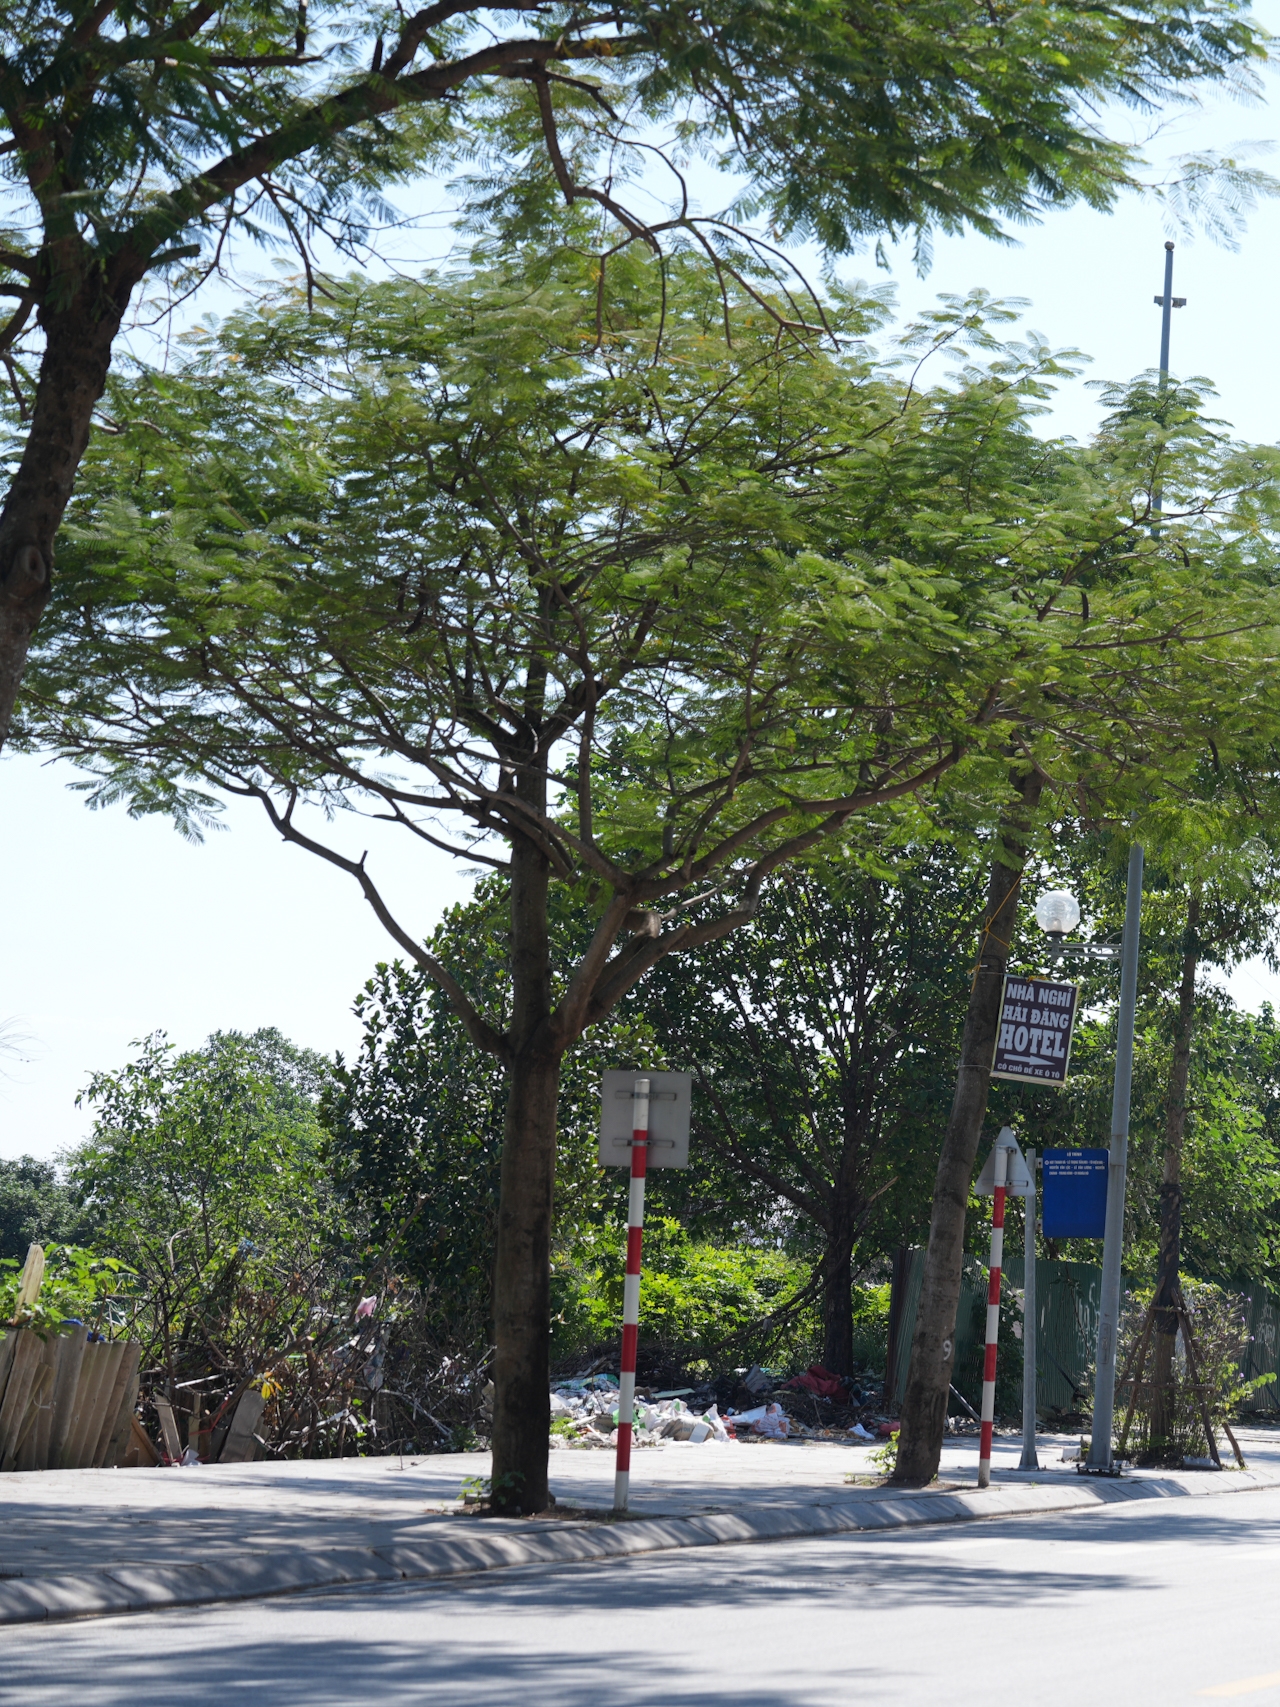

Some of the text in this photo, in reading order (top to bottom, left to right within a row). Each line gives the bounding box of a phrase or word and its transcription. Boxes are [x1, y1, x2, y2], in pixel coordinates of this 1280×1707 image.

[1006, 983, 1073, 1007] NHÀ NGHỈ
[1002, 1002, 1070, 1029] HẢI ĐĂNG
[998, 1023, 1065, 1058] HOTEL
[943, 1340, 952, 1360] 9
